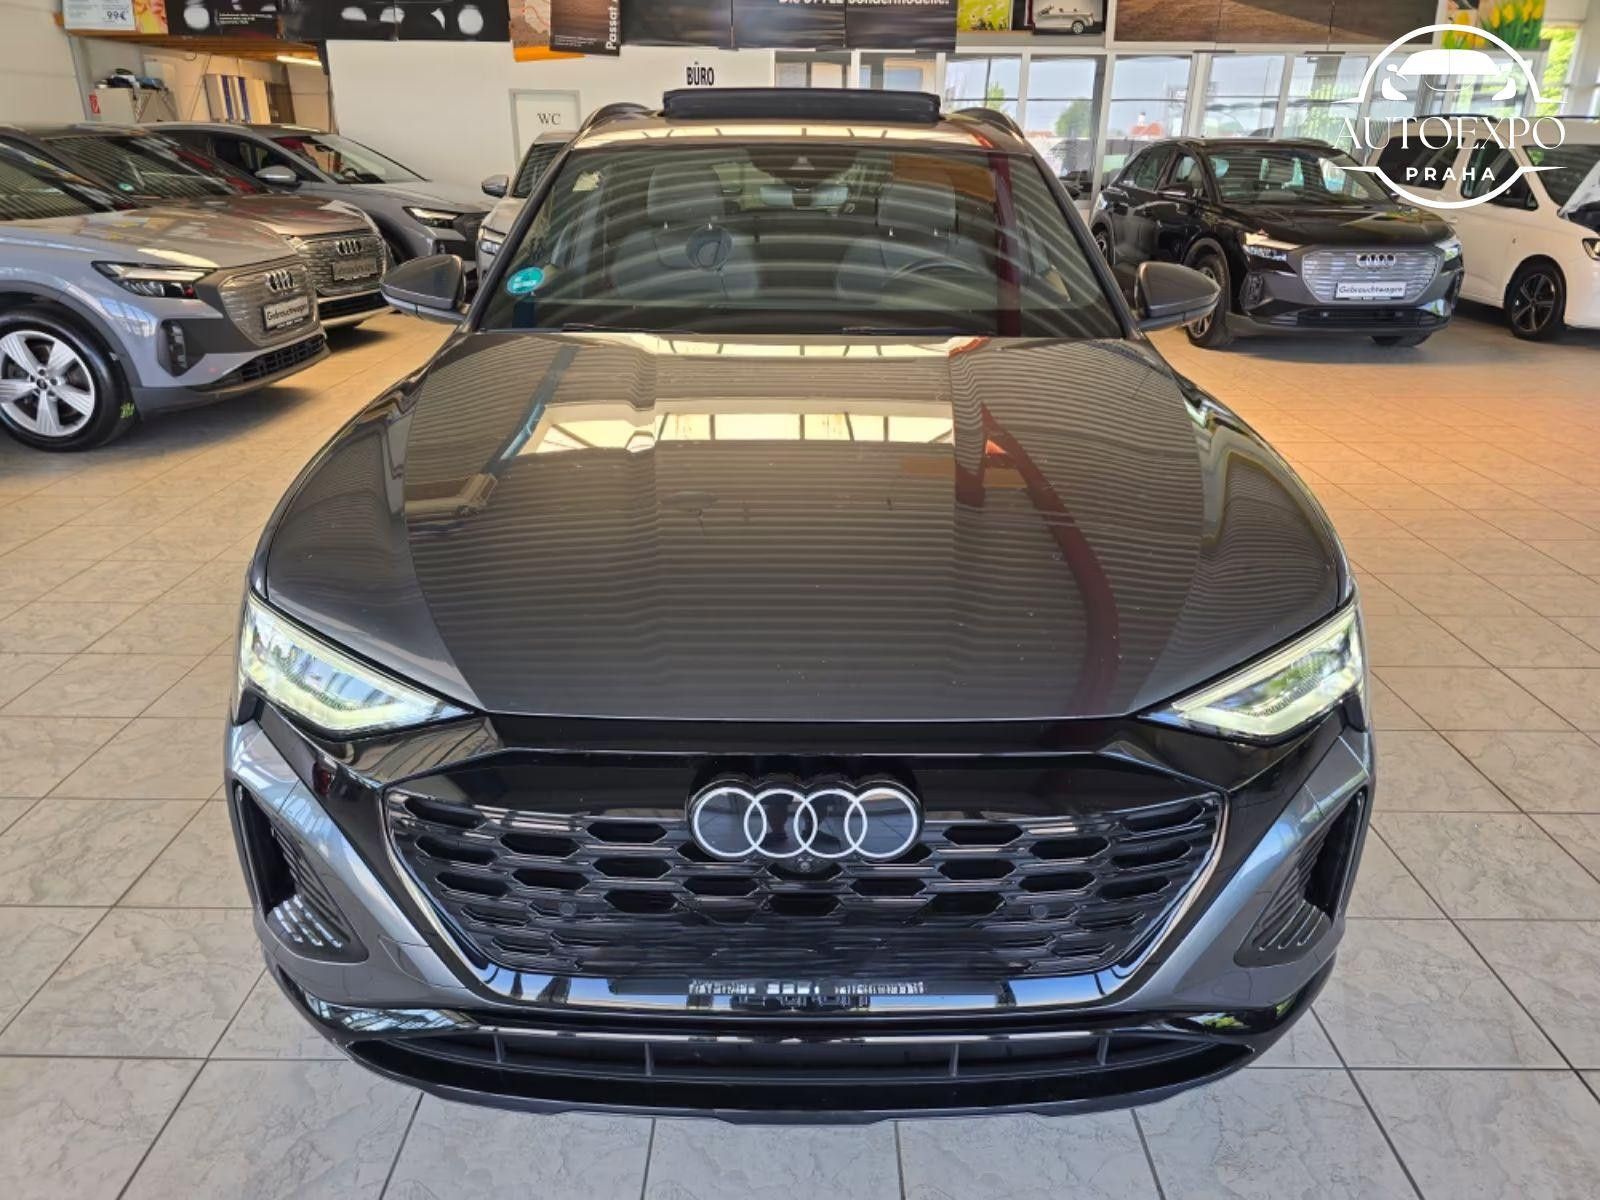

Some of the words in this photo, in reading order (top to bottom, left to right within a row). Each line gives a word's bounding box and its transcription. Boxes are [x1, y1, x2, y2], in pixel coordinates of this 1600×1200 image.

[605, 6, 618, 50] Passat
[686, 60, 715, 86] BÜRO
[536, 112, 561, 126] WC
